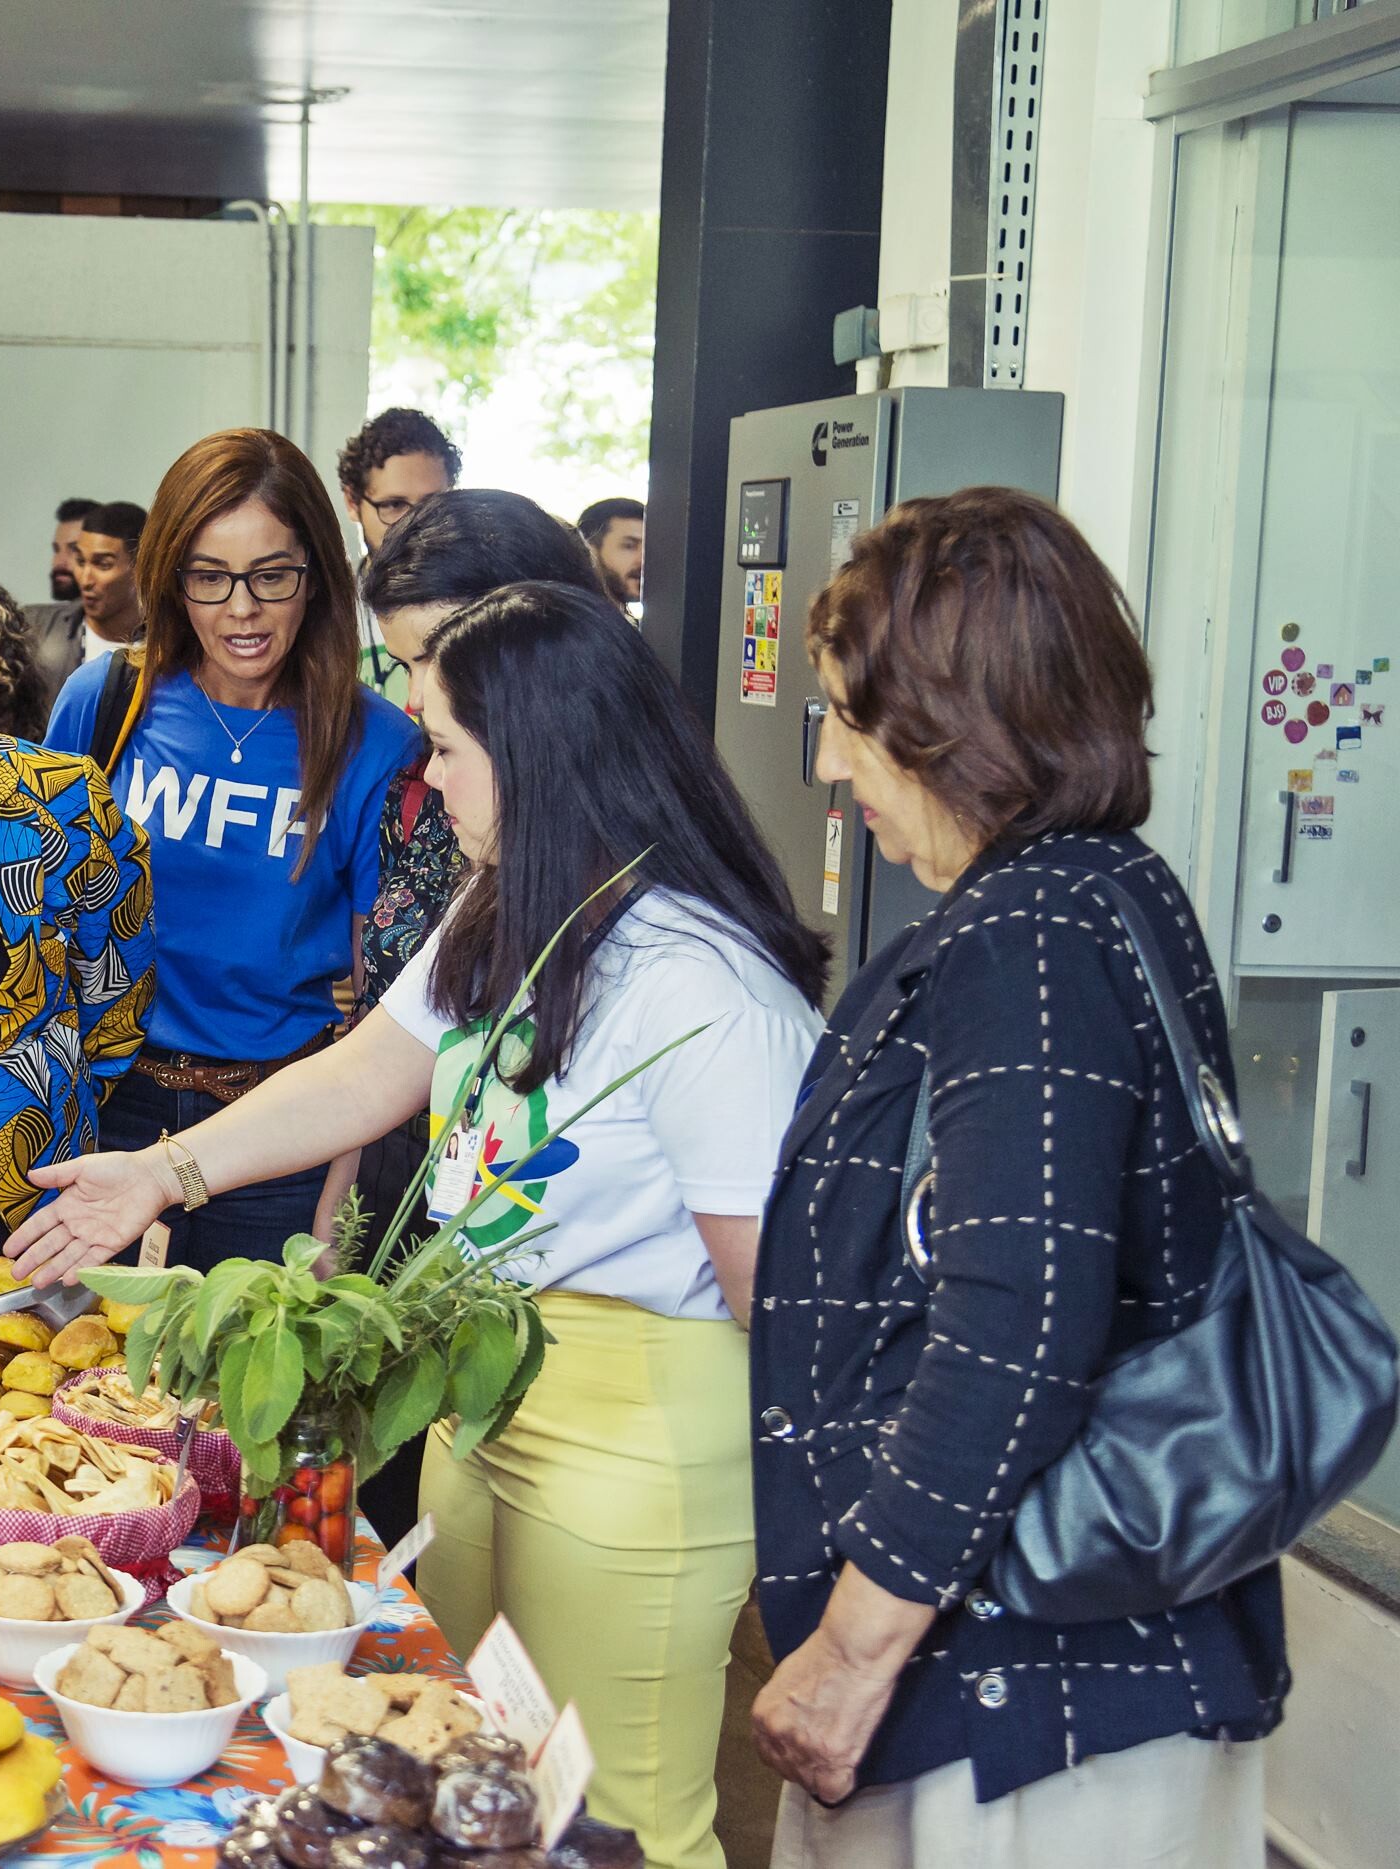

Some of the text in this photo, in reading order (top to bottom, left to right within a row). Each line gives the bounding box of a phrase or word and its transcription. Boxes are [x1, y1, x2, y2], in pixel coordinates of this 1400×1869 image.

[832, 421, 854, 433] Power
[831, 433, 869, 449] Generation
[1267, 675, 1286, 692] VIP
[125, 757, 328, 858] WFP
